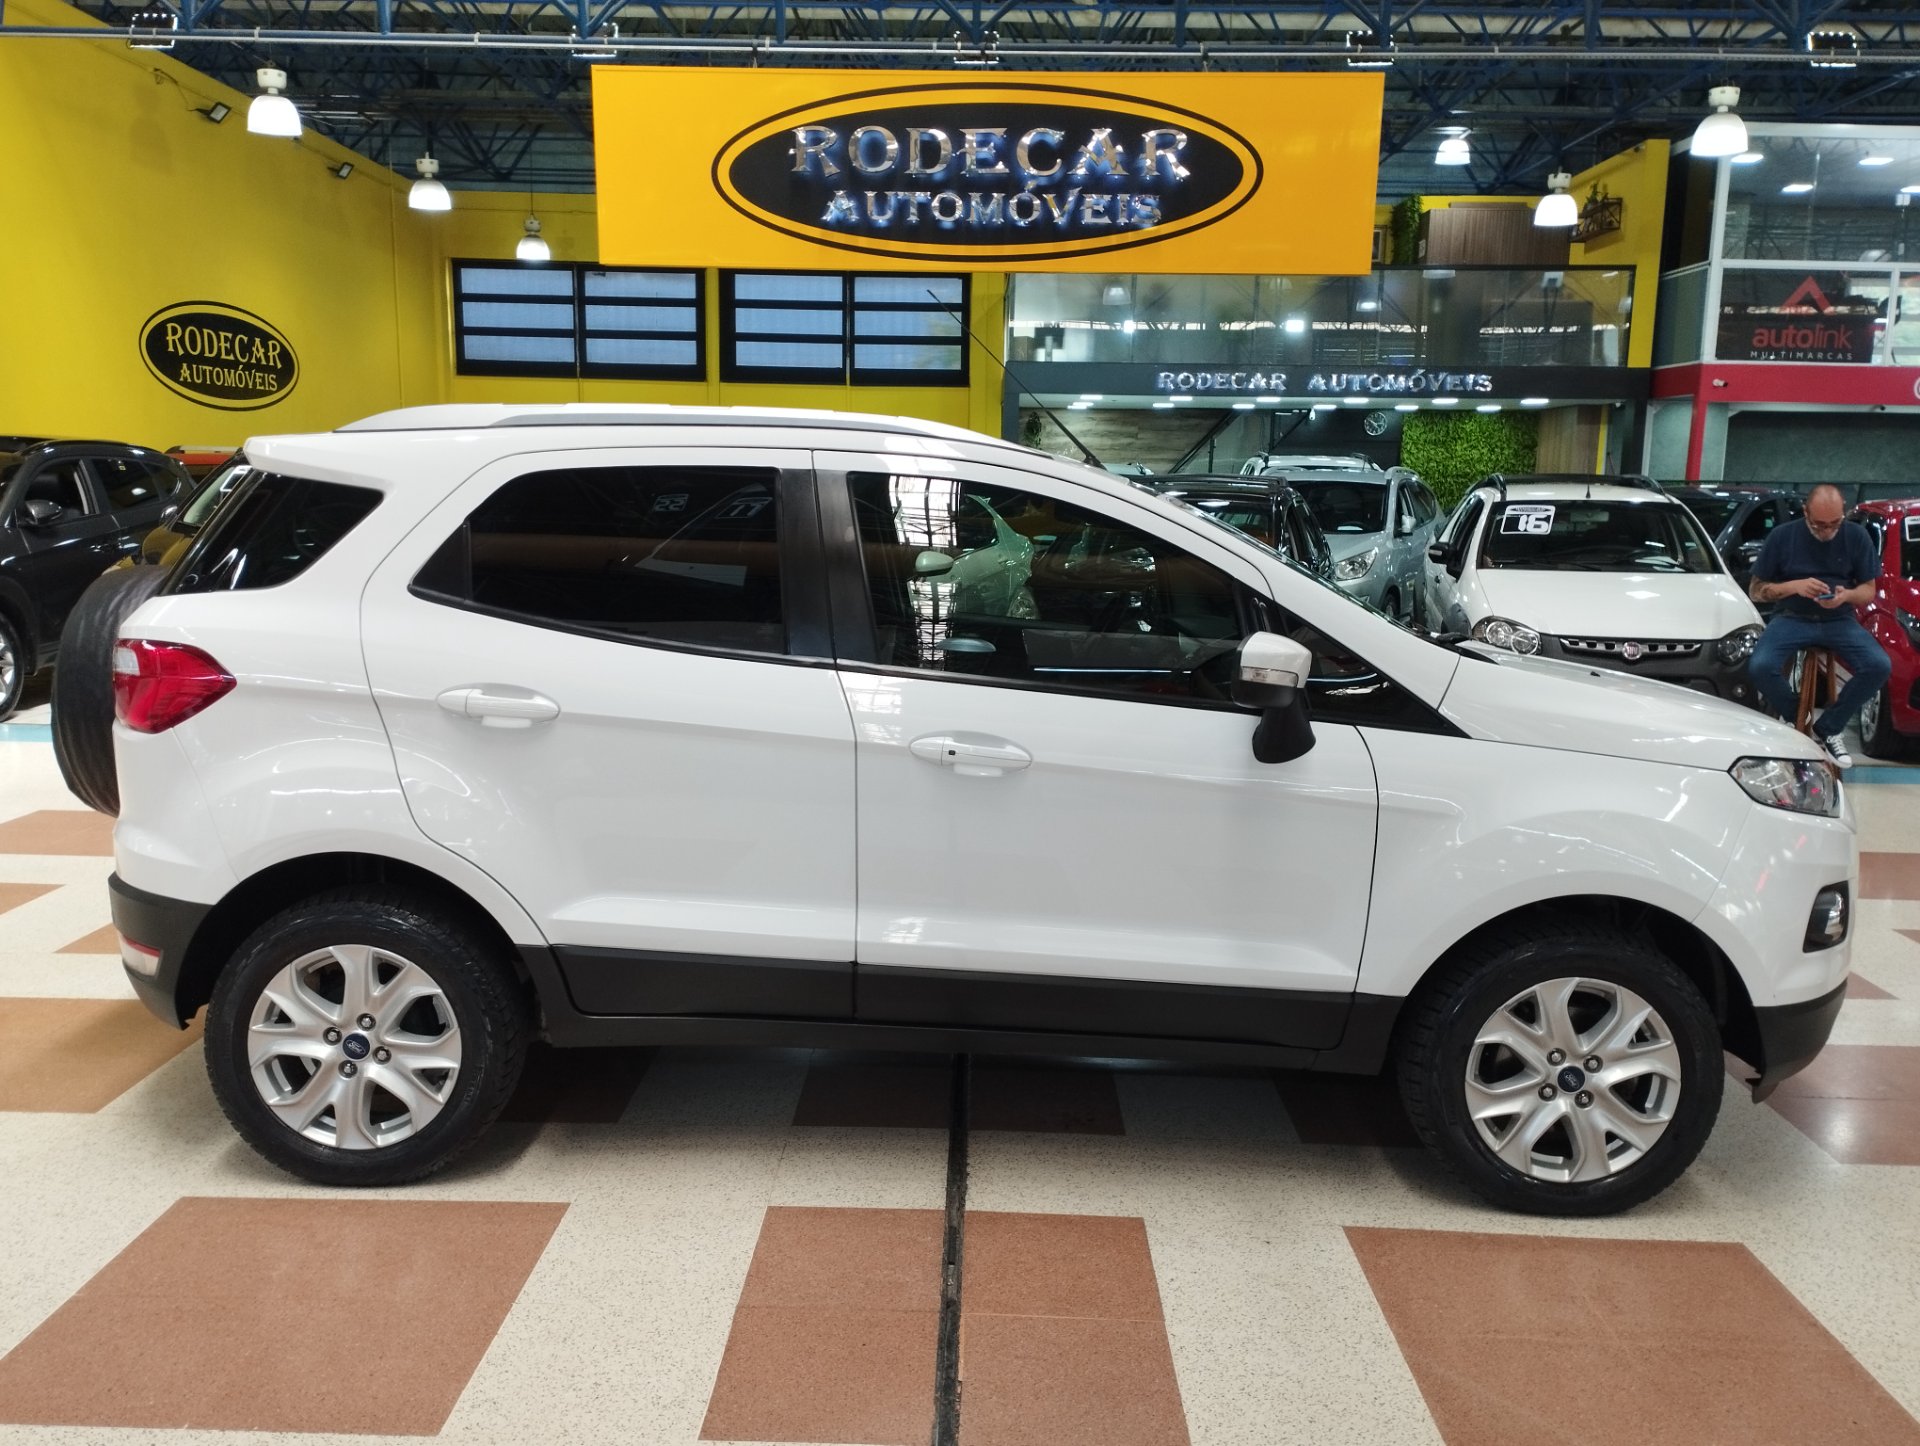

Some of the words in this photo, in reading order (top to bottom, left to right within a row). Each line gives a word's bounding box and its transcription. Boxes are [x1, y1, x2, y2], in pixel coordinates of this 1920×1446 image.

[788, 125, 1190, 181] RODECAR
[820, 180, 1163, 225] AUTOMÓVEIS
[166, 322, 282, 369] RODECAR
[1752, 324, 1852, 349] autolink
[1750, 350, 1853, 360] MULTIMARCAS
[179, 362, 278, 391] AUTOMÓVEIS
[1158, 371, 1287, 391] RODECAR
[1307, 368, 1493, 392] AUTOMÓVEIS
[1518, 514, 1549, 532] 16
